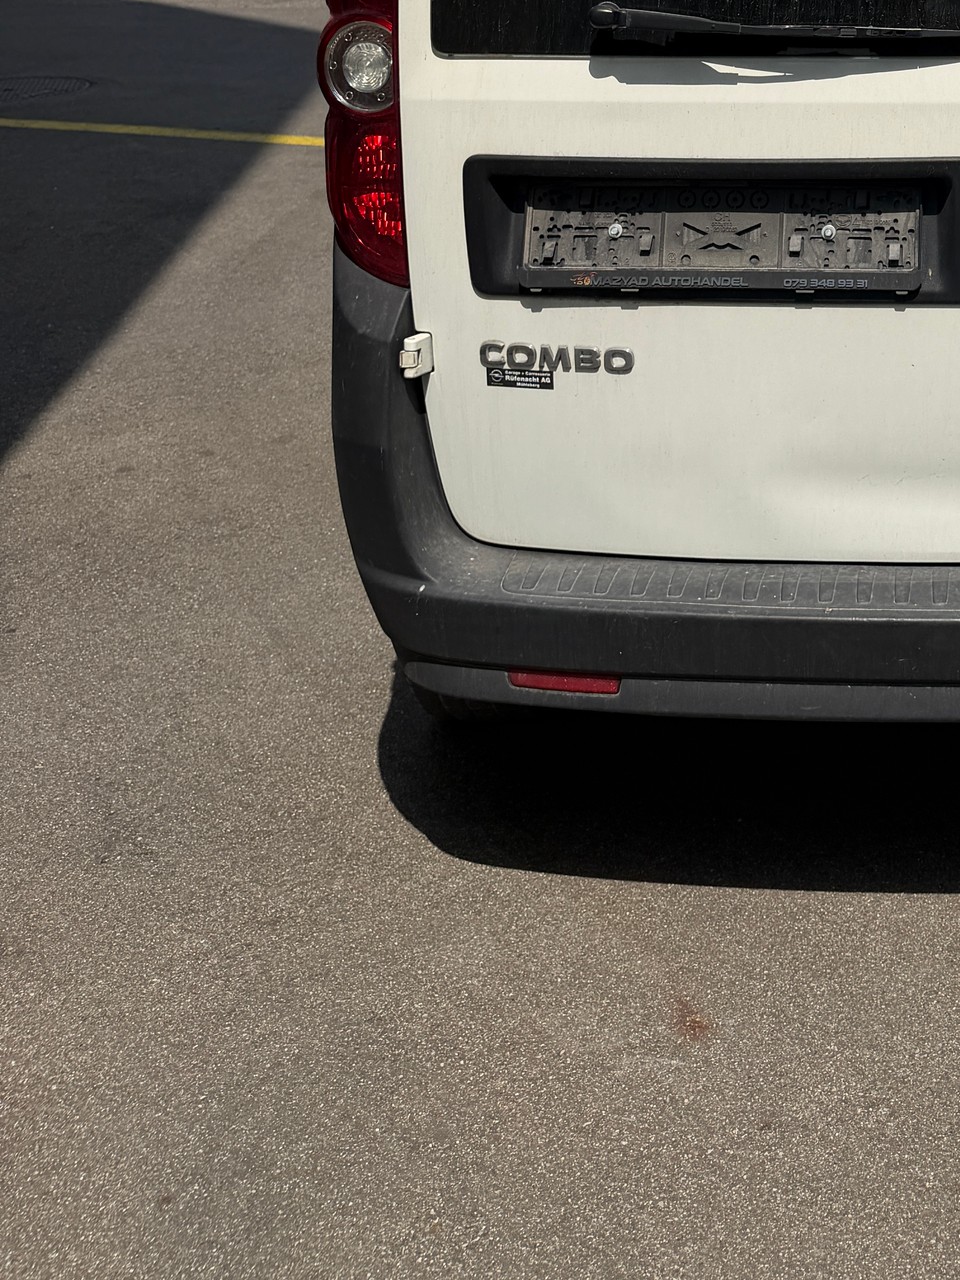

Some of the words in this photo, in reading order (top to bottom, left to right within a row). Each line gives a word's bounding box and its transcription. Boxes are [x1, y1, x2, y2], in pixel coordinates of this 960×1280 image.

[590, 276, 649, 287] MAZYAD
[651, 277, 749, 288] AUTOHANDEL
[783, 278, 808, 288] 079
[809, 278, 835, 288] 348
[837, 279, 853, 289] 93
[855, 279, 869, 289] 31
[479, 339, 635, 375] COMBO
[504, 375, 540, 383] Rüfenacht
